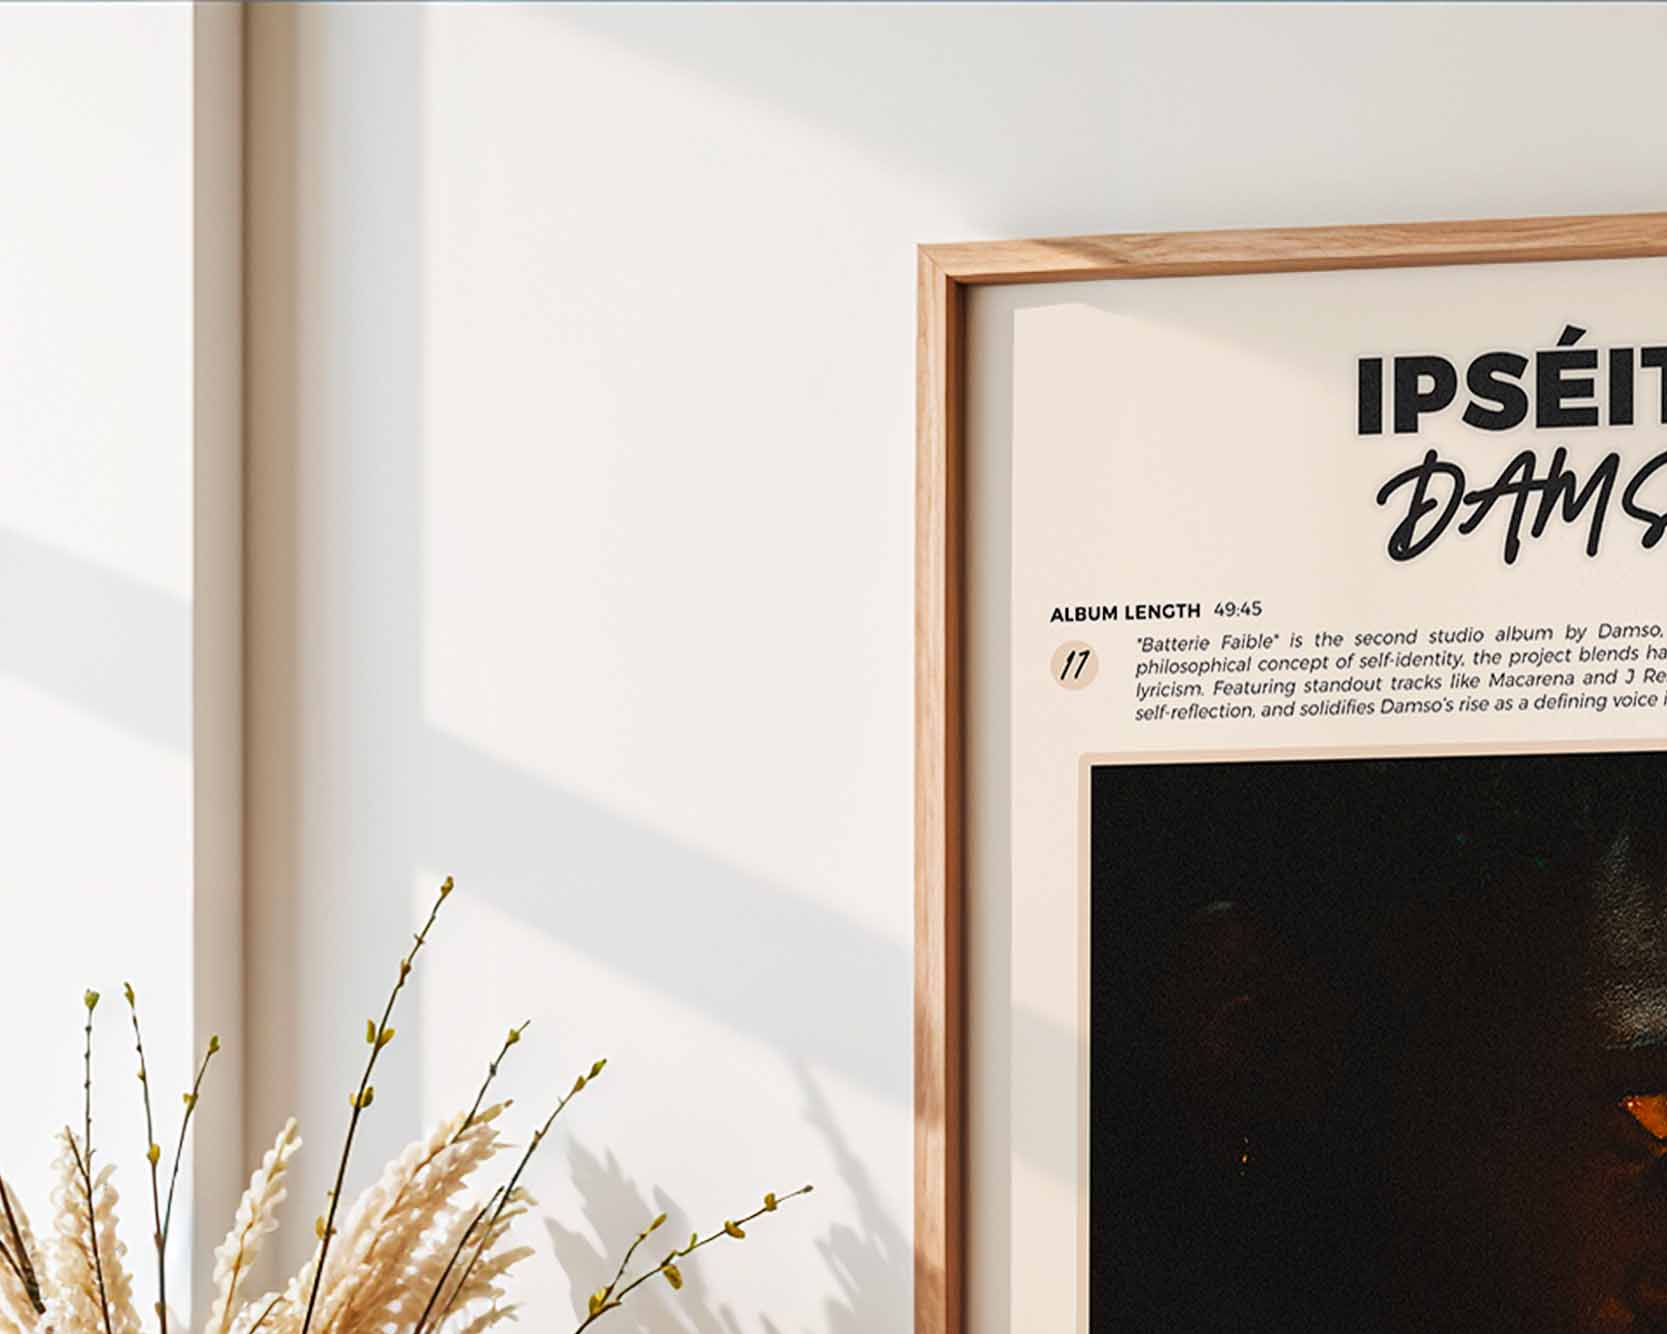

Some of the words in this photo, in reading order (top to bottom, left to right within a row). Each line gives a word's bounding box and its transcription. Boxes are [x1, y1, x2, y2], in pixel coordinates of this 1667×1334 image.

[1050, 605, 1117, 623] ALBUM
[1125, 603, 1200, 620] LENGTH
[1214, 601, 1262, 617] 49:45
[1290, 632, 1302, 648] is
[1315, 632, 1343, 648] the
[1354, 629, 1418, 647] second
[1429, 627, 1484, 644] studio
[1495, 626, 1553, 642] album
[1565, 624, 1587, 643] by
[1598, 623, 1663, 639] Damso,
[1135, 656, 1251, 678] philosophical
[1258, 656, 1329, 673] concept
[1336, 653, 1355, 669] of
[1360, 650, 1464, 670] self-identity,
[1473, 649, 1502, 665] the
[1508, 648, 1572, 668] project
[1579, 645, 1639, 662] blends
[1136, 681, 1204, 702] lyricism.
[1213, 678, 1296, 698] Featuring
[1304, 676, 1382, 693] standout
[1391, 674, 1442, 691] tracks
[1450, 673, 1480, 688] like
[1489, 672, 1574, 688] Macarena
[1583, 669, 1618, 686] and
[1625, 668, 1635, 684] J
[1136, 703, 1255, 721] self-reflection,
[1261, 701, 1295, 718] and
[1300, 699, 1375, 716] solidifies
[1459, 696, 1489, 712] rise
[1494, 698, 1512, 711] as
[1518, 698, 1528, 710] a
[1534, 693, 1607, 712] defining
[1613, 691, 1658, 708] voice
